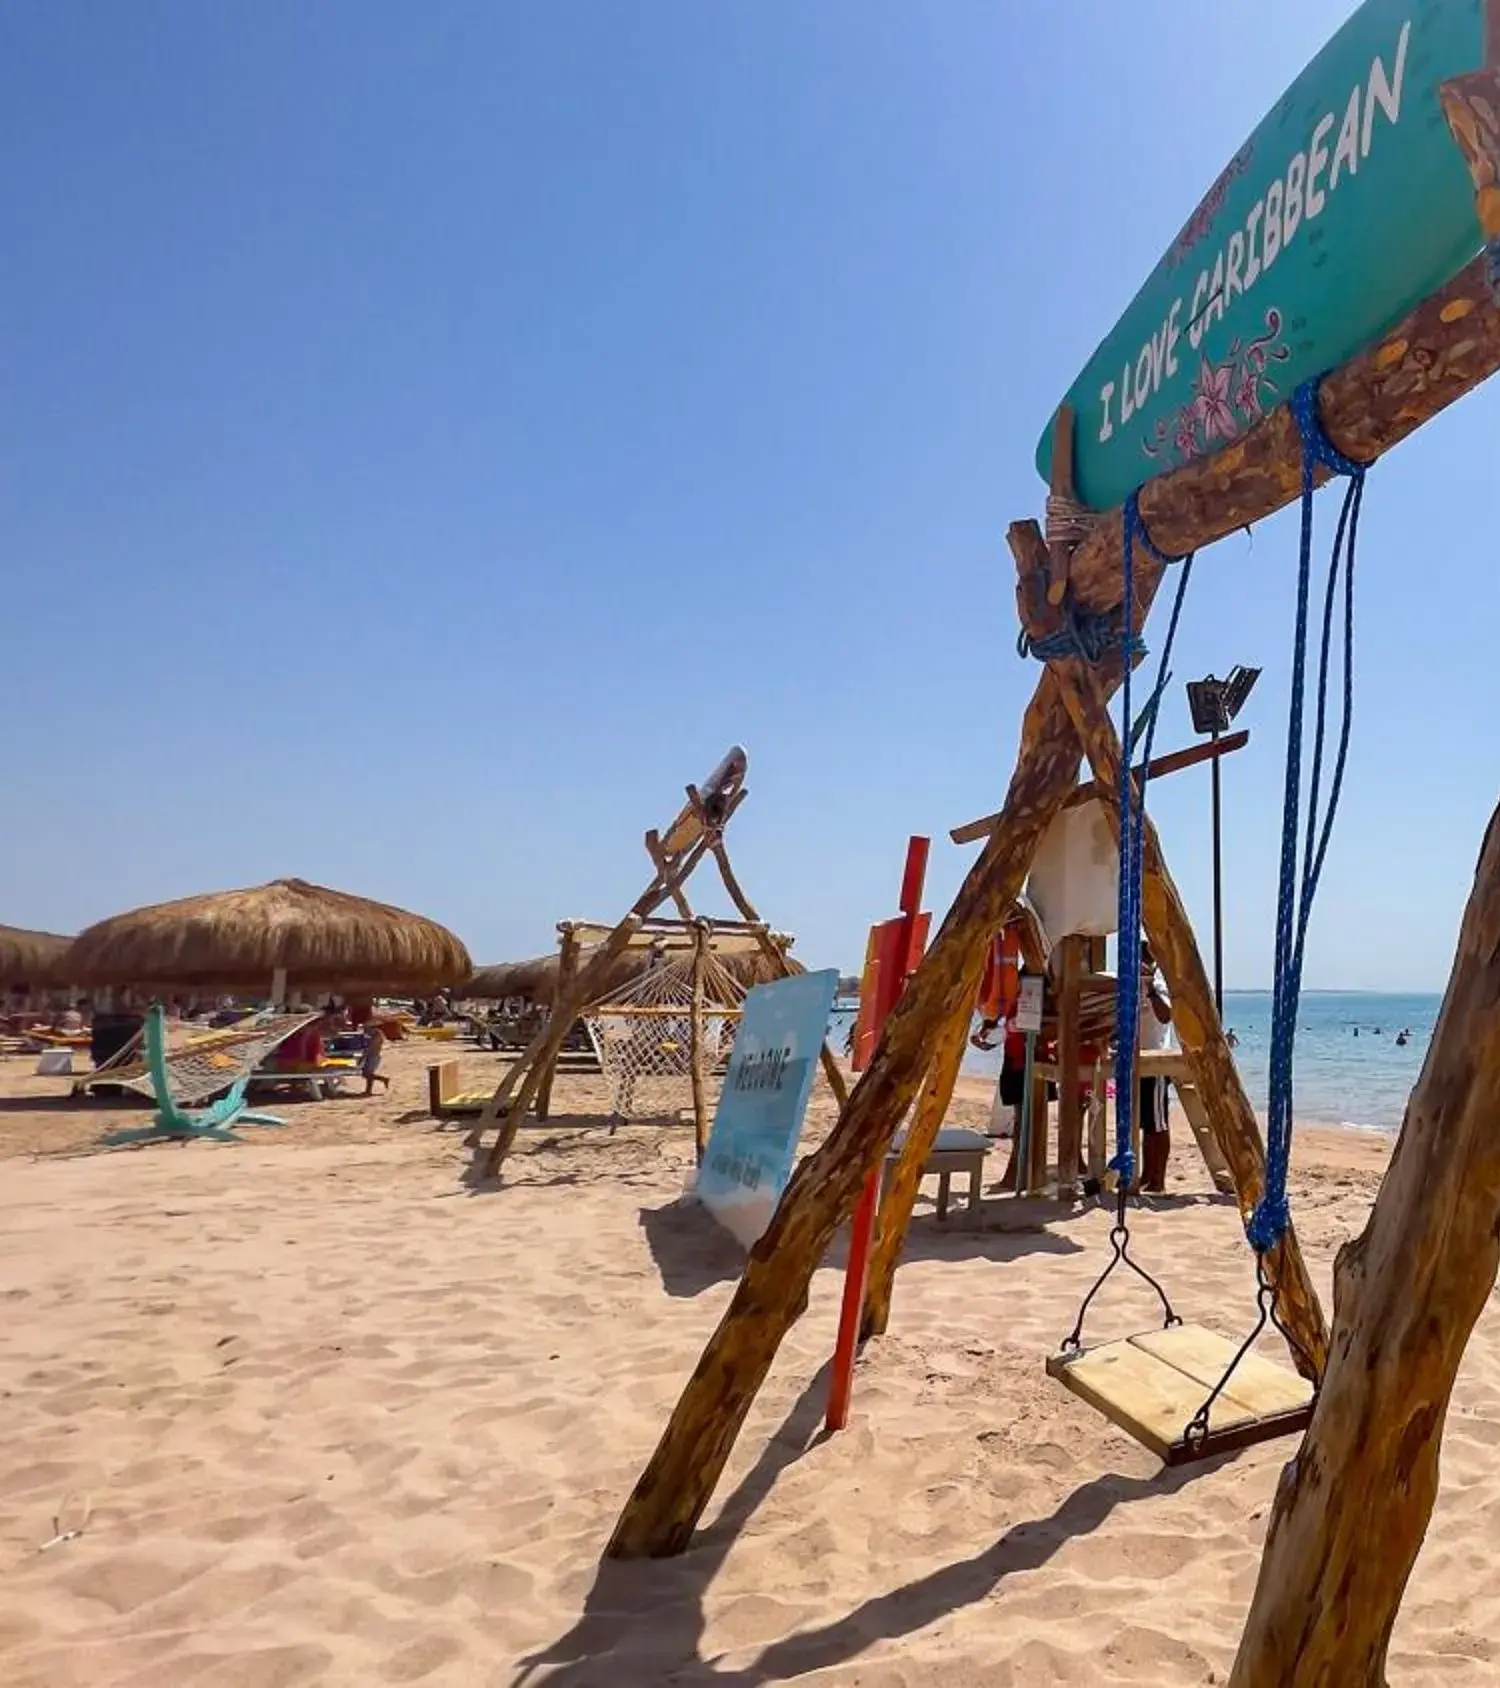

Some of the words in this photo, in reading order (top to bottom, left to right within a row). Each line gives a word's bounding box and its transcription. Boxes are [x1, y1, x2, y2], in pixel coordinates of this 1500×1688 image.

[1099, 380, 1114, 443] I
[1119, 298, 1181, 425] LOVE
[1189, 20, 1411, 349] CARIBBEAN
